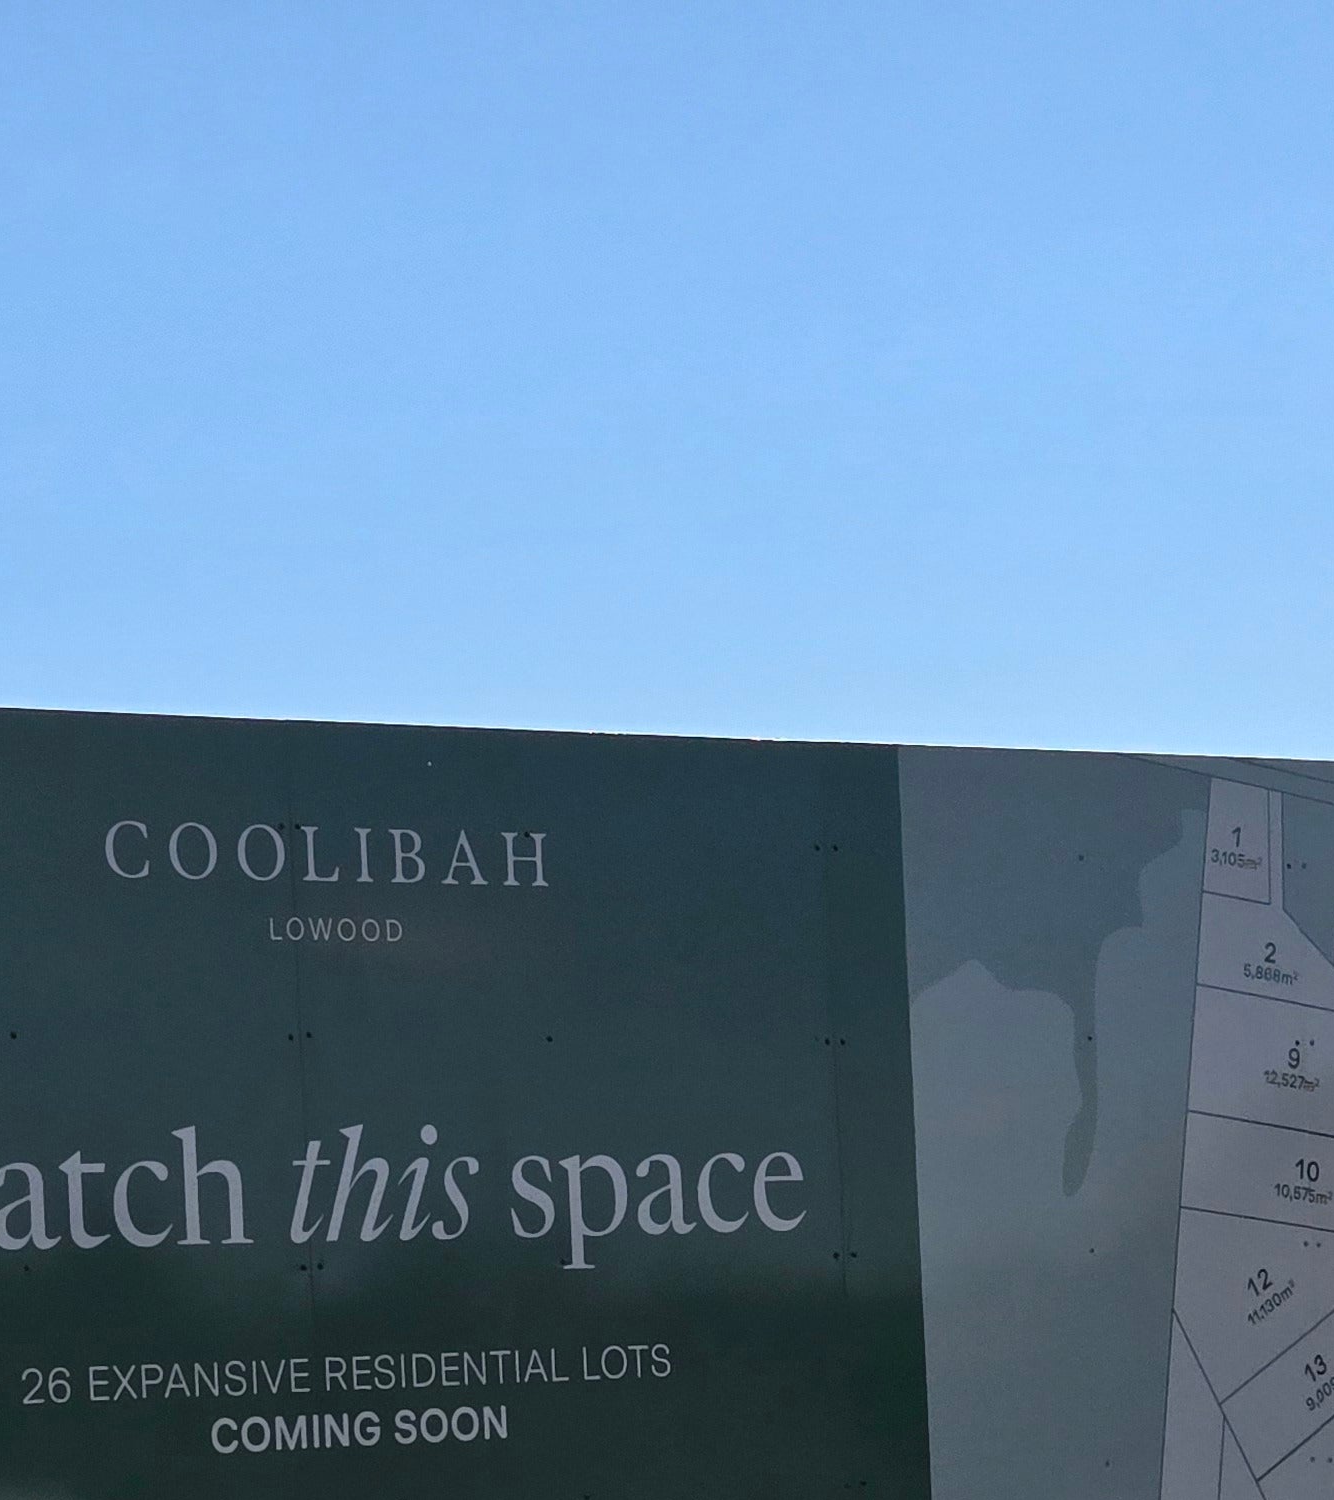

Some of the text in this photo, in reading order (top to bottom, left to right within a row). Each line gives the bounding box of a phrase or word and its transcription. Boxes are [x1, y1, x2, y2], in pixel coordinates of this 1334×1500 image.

[1232, 827, 1241, 847] 1
[105, 821, 548, 886] COOLIBAH
[270, 917, 402, 941] LOWOOD
[1264, 942, 1276, 964] 2
[1288, 1048, 1301, 1069] 9
[1296, 1159, 1319, 1182] 10
[291, 1124, 479, 1243] this
[511, 1152, 806, 1269] space
[1246, 1269, 1273, 1297] 12
[22, 1344, 670, 1404] 26 EXPANSIVE RESIDENTIAL LOTS
[1304, 1355, 1327, 1382] 13
[211, 1405, 507, 1453] COMING SOON
